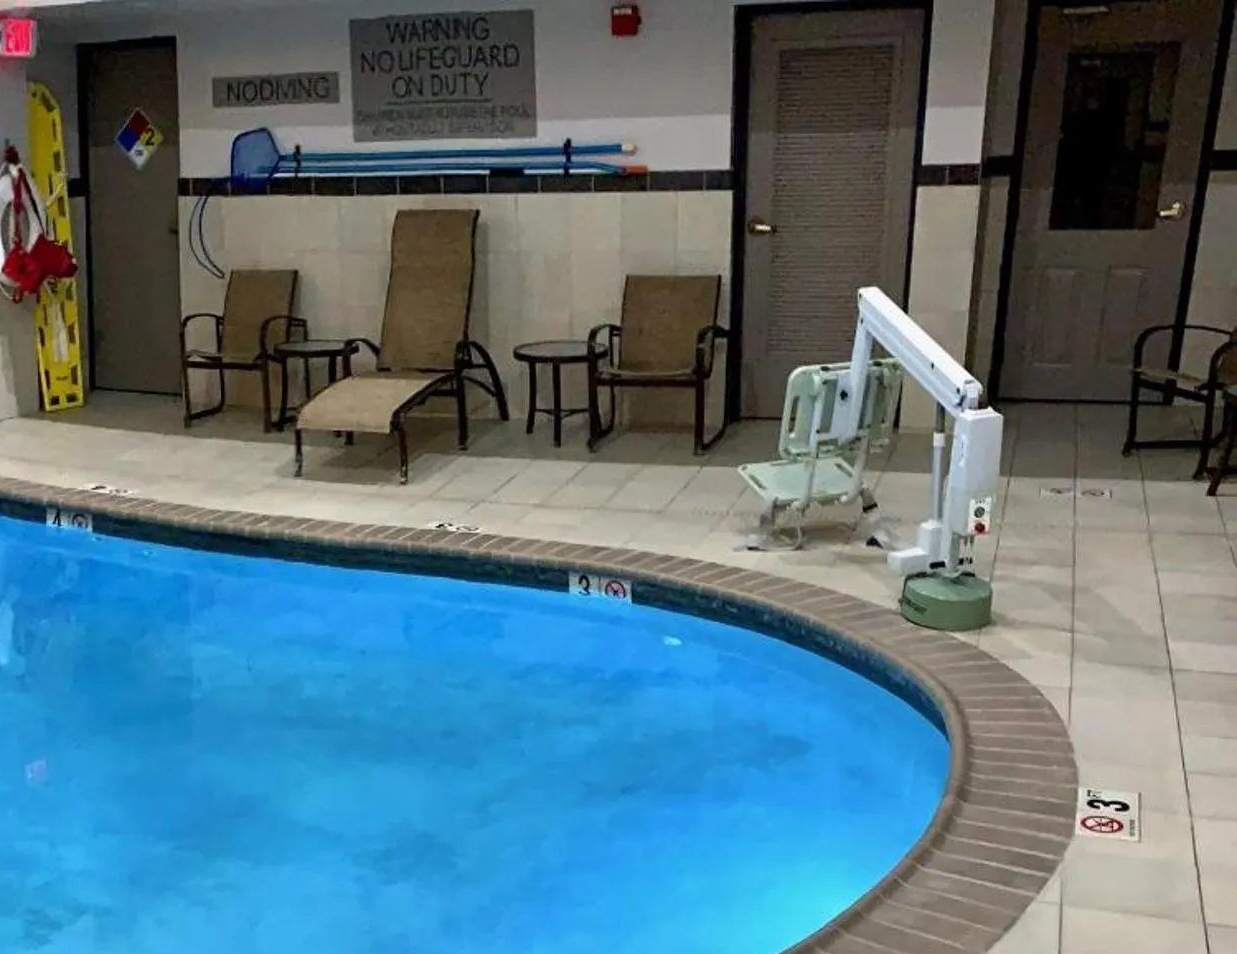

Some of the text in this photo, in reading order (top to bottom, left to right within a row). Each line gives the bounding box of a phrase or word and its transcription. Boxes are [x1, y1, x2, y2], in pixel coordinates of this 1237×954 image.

[386, 16, 490, 44] WARNING
[360, 44, 521, 73] NO LIFEGUARD
[392, 72, 489, 98] ON DUTY
[144, 129, 155, 146] 2
[1086, 798, 1131, 813] 3
